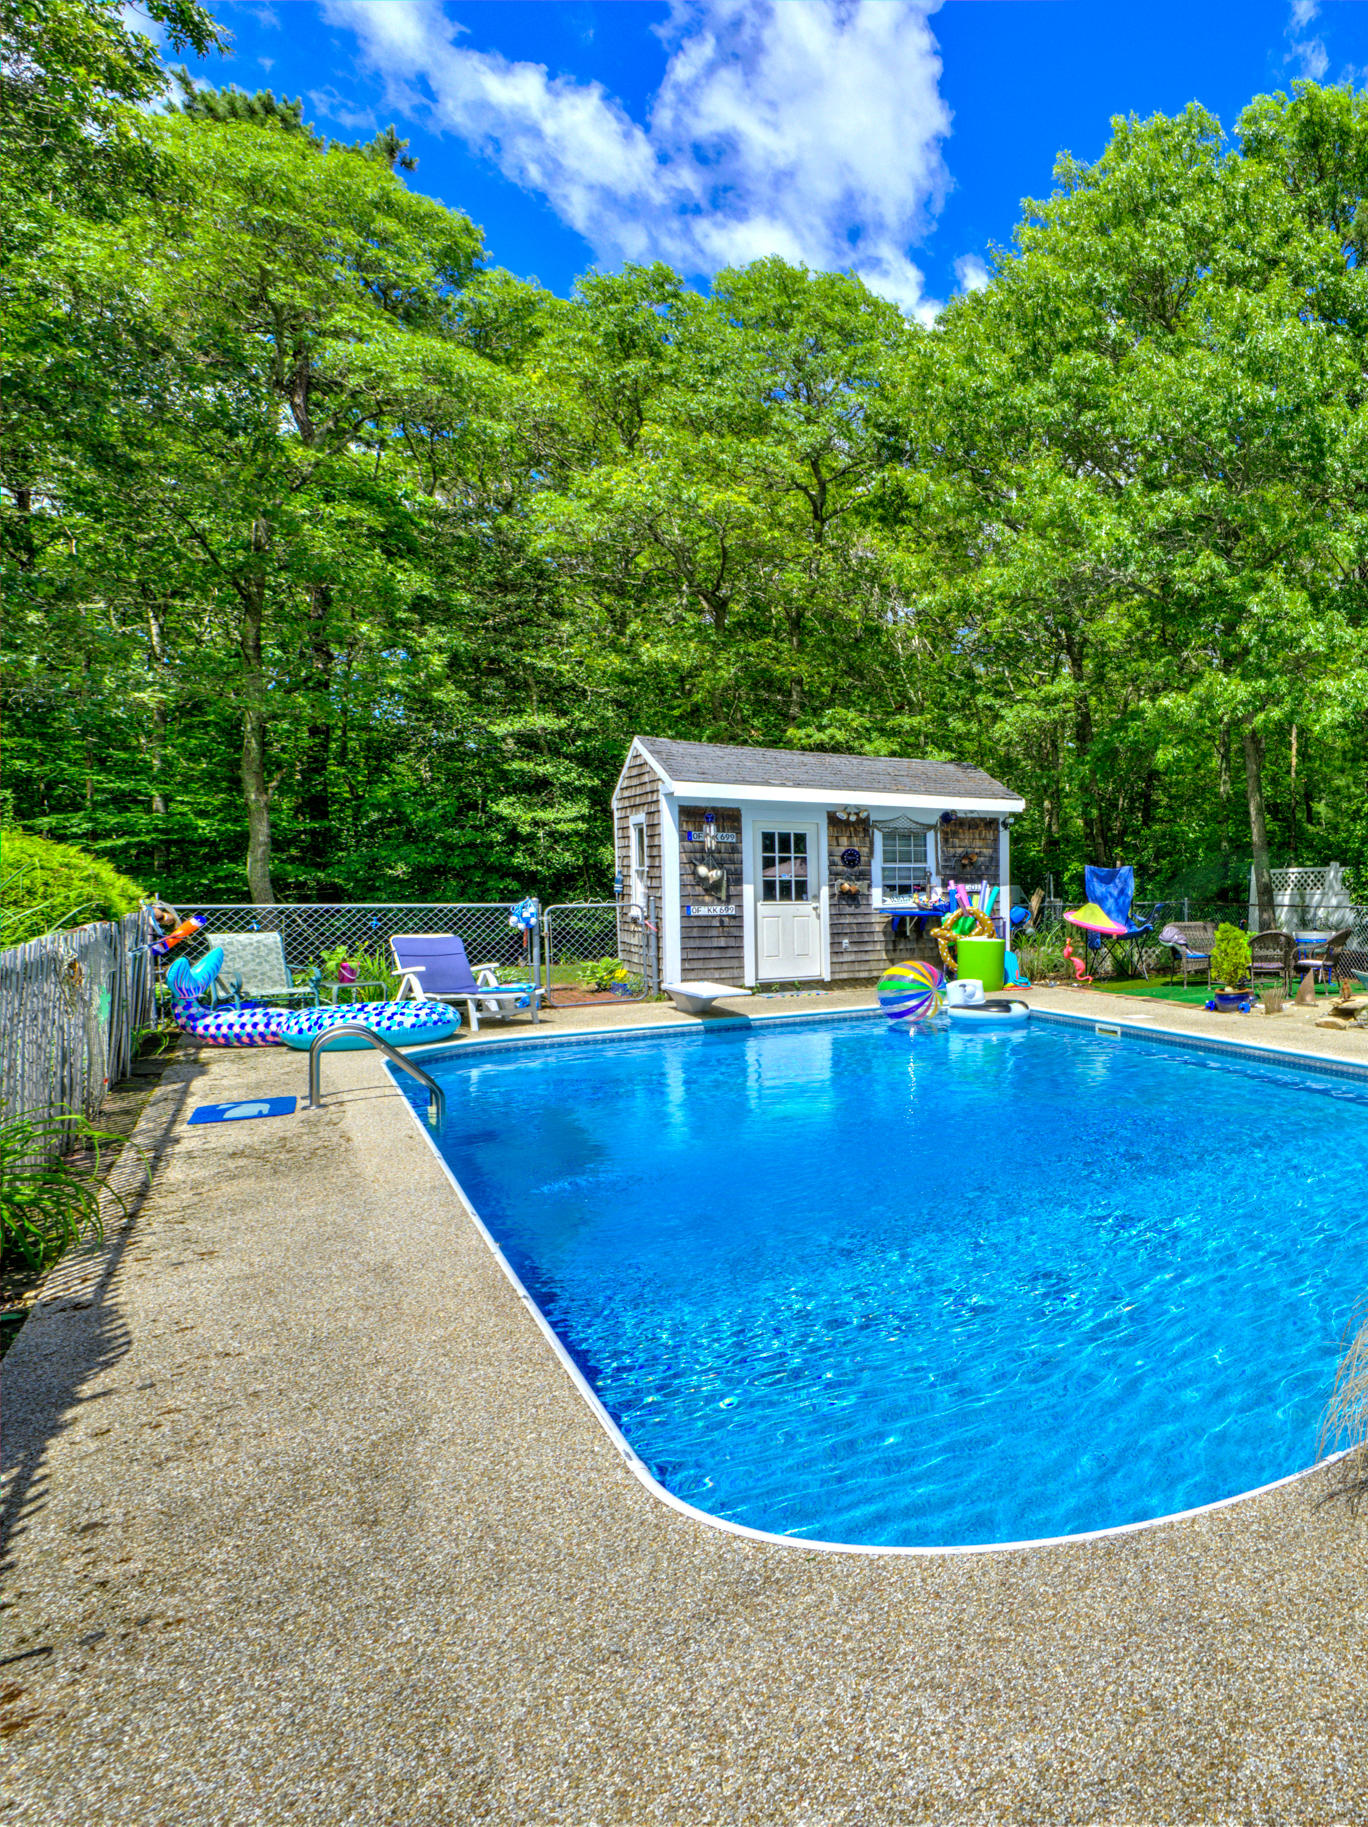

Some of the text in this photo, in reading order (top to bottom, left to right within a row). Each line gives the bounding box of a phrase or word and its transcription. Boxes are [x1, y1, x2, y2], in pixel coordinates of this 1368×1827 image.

[720, 833, 735, 841] 699
[707, 906, 718, 914] KK
[719, 906, 735, 914] 699
